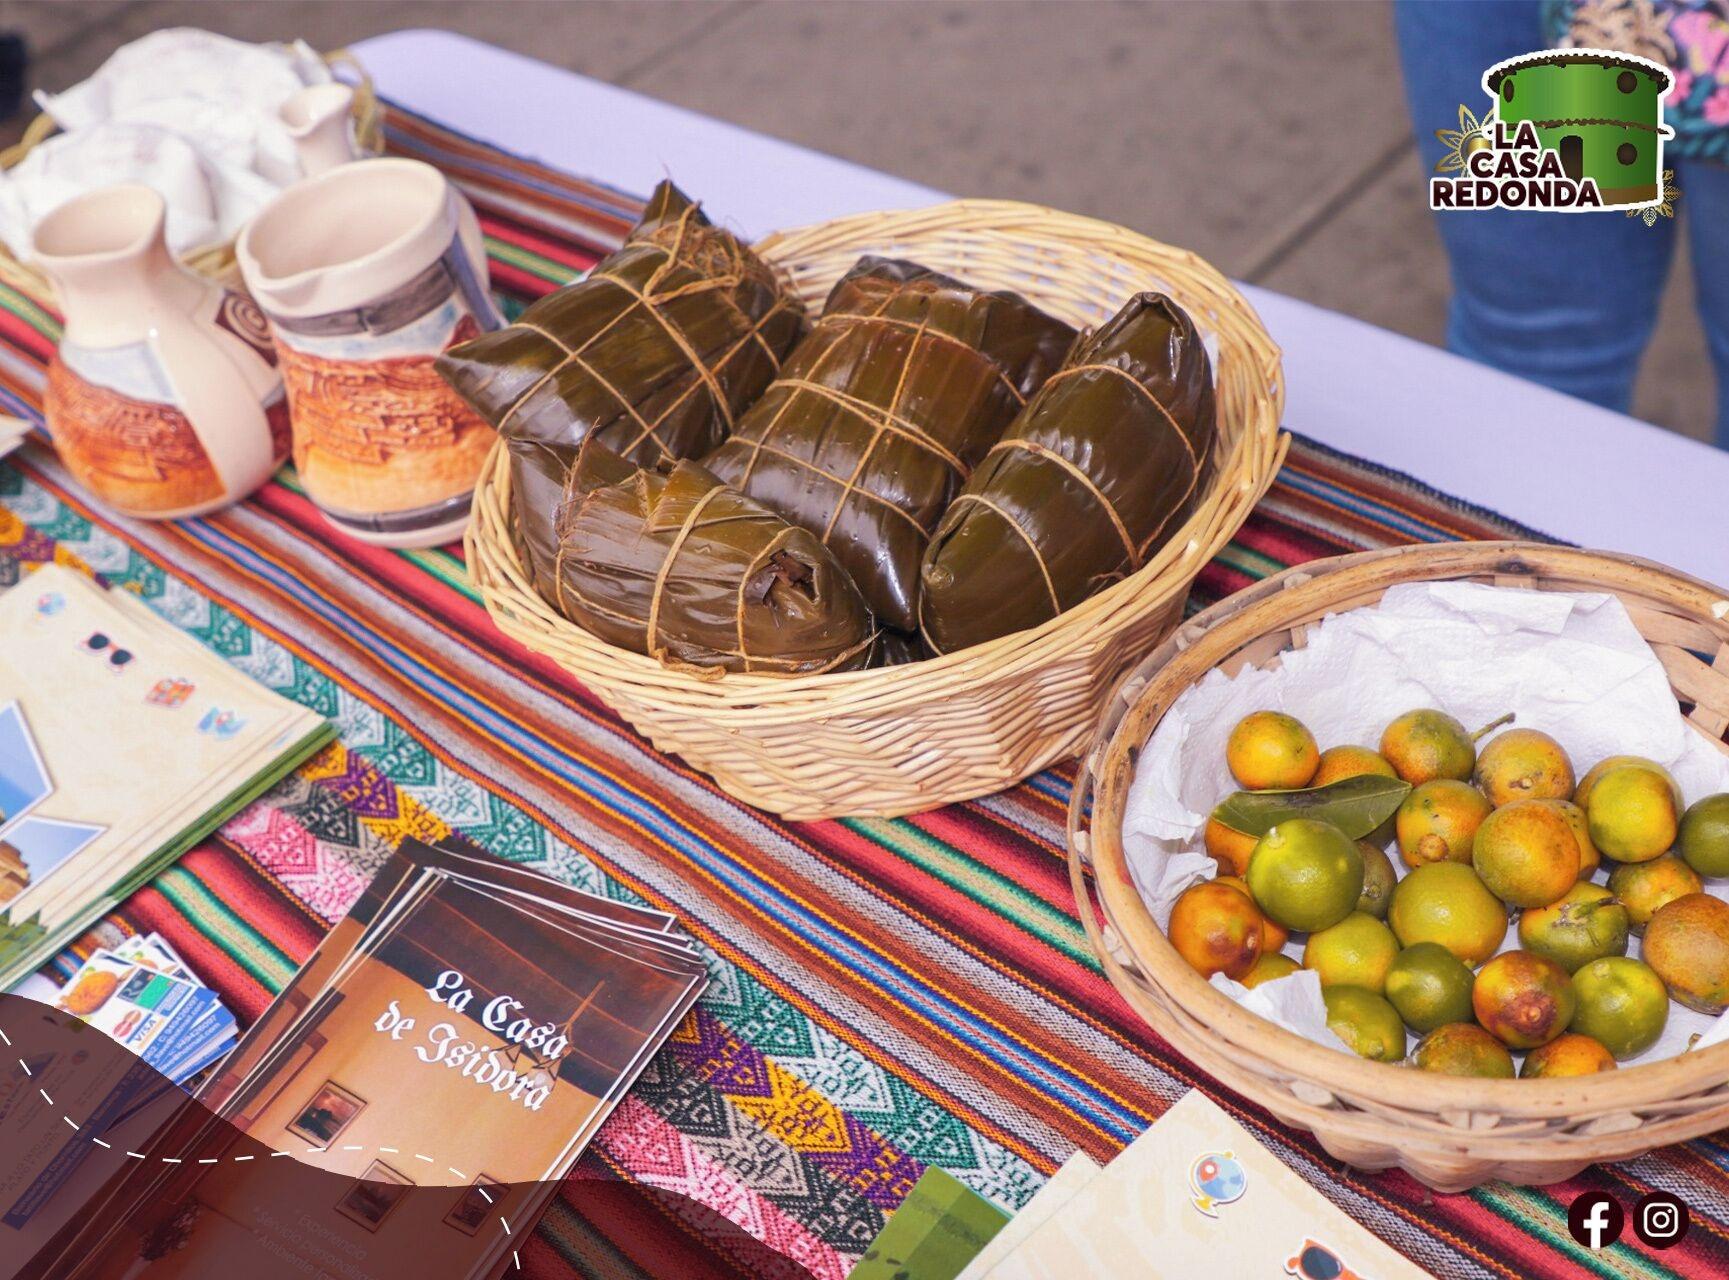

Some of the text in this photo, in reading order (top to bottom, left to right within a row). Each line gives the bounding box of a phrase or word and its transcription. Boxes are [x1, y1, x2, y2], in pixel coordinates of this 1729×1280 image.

[134, 1018, 157, 1042] VISA
[374, 1000, 550, 1111] de Isidora
[425, 970, 568, 1059] La Casa
